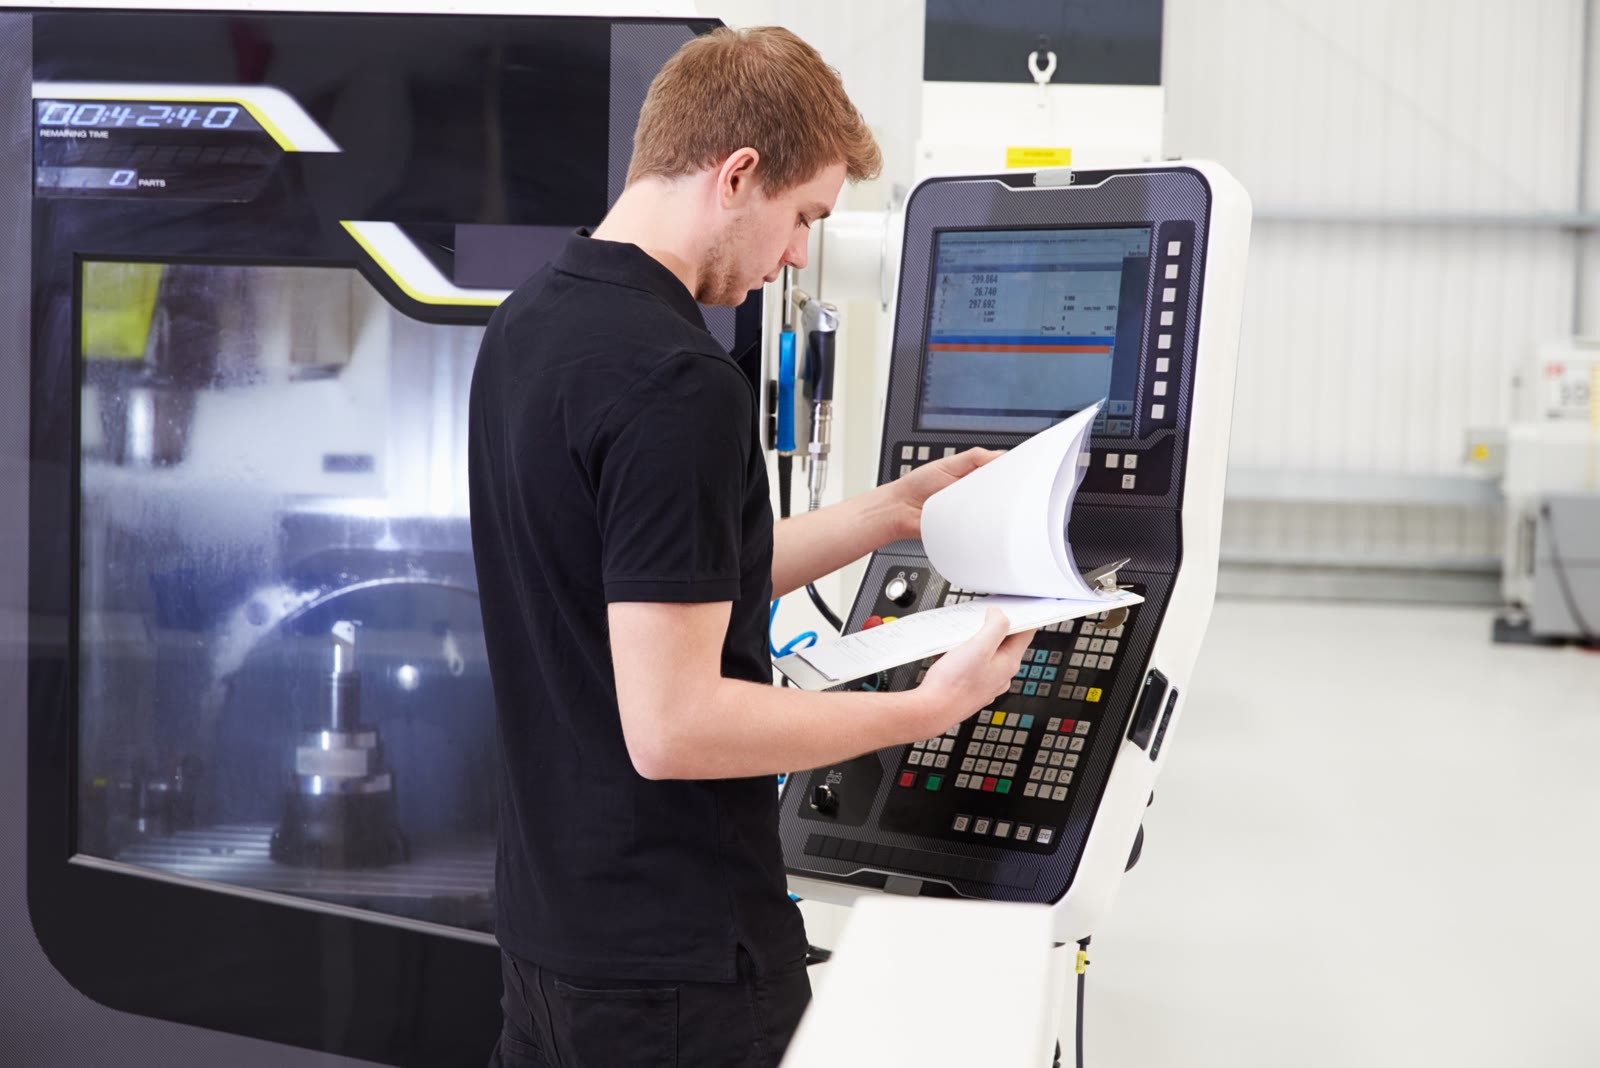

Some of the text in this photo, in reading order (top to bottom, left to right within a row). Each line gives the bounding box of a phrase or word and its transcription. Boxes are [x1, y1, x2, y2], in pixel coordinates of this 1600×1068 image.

[39, 129, 109, 139] REMAINING TIME
[138, 178, 166, 188] PARTS
